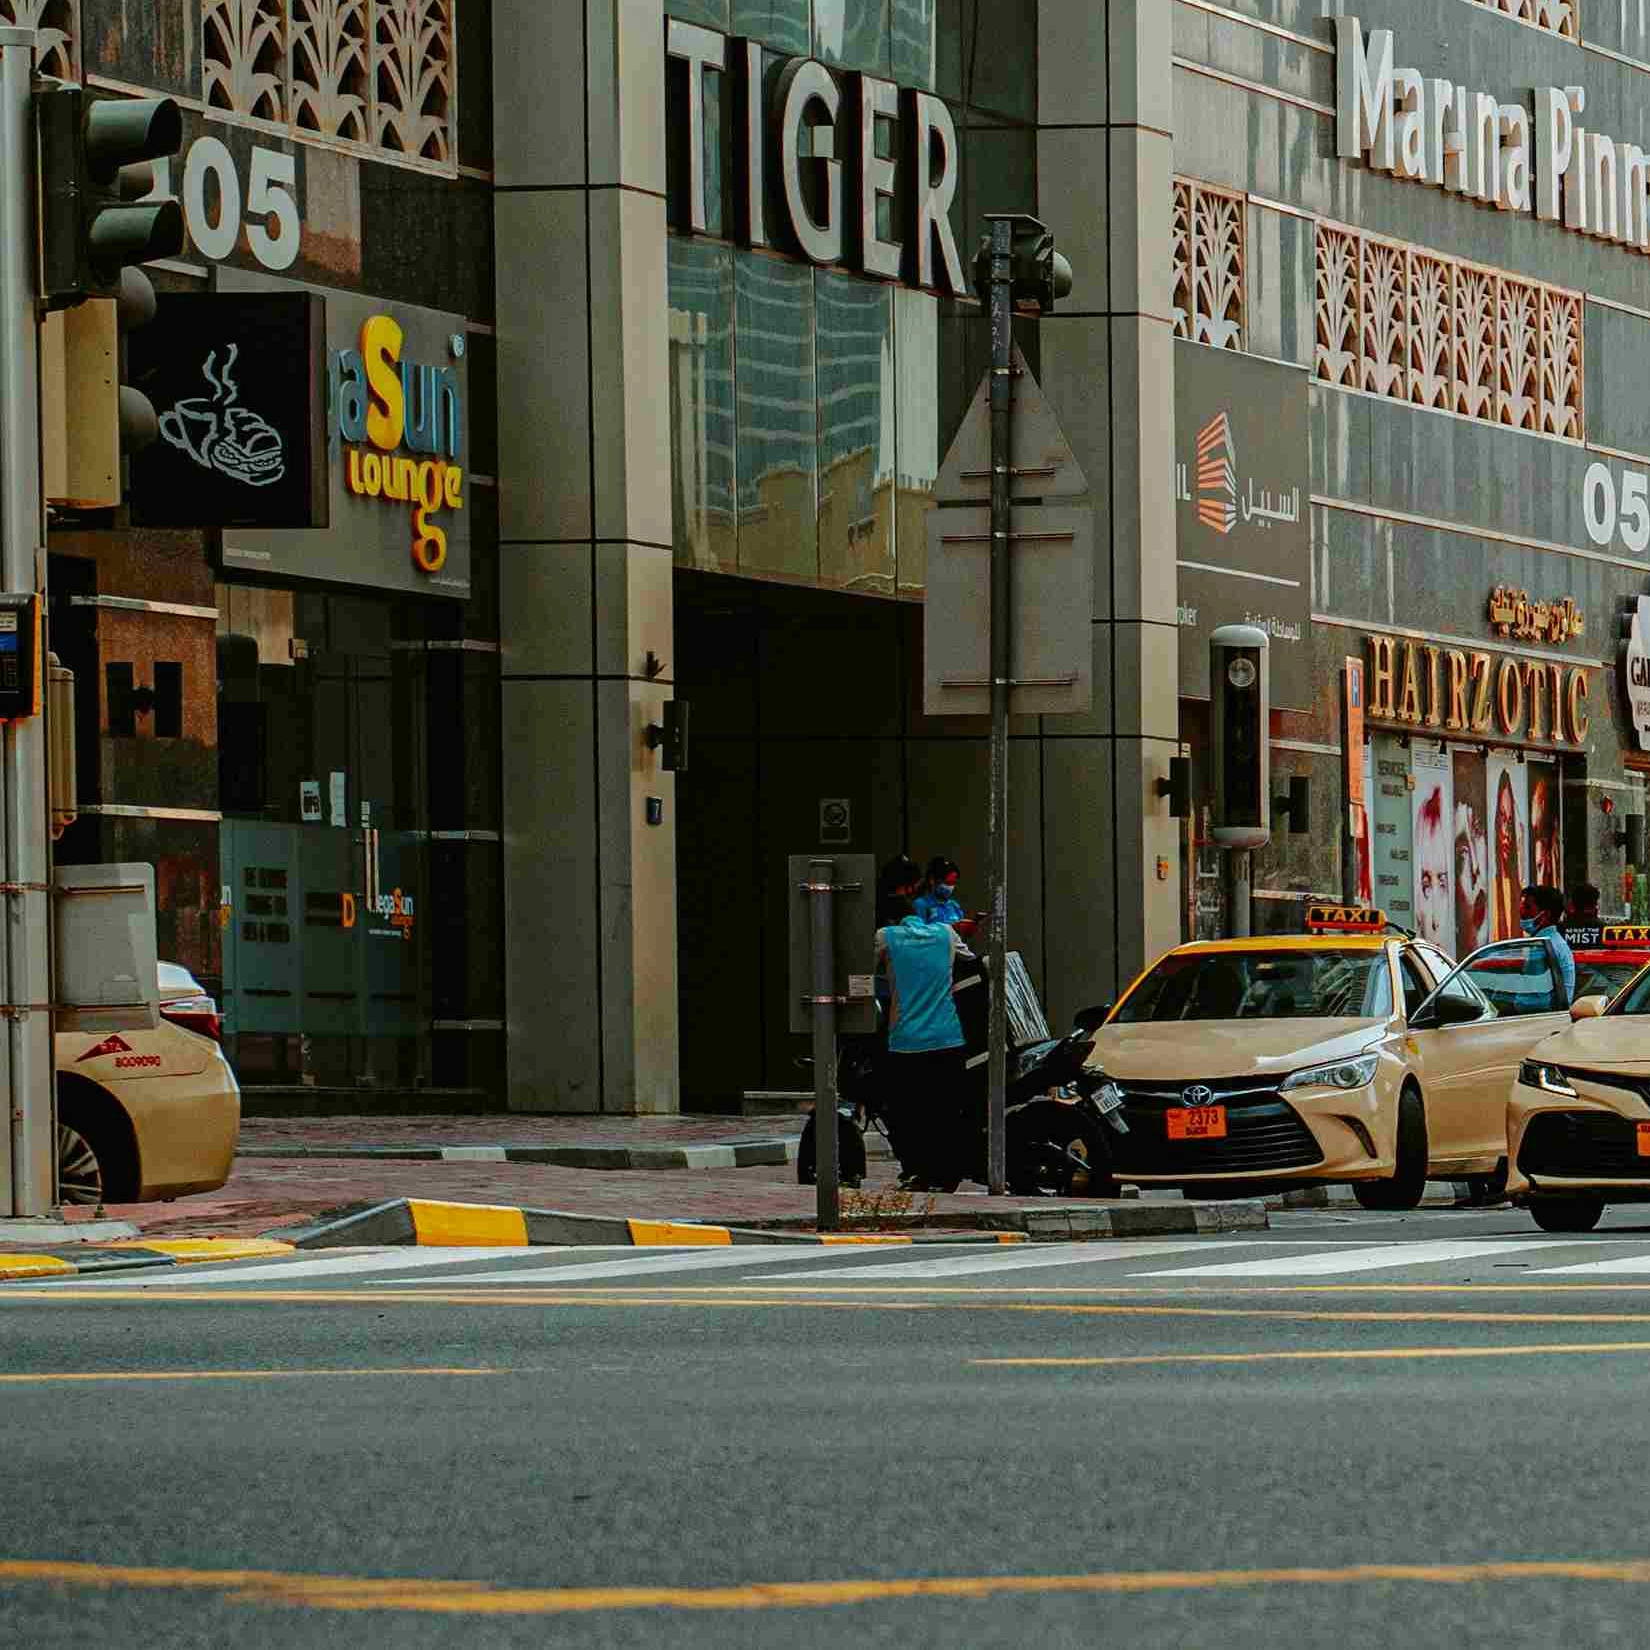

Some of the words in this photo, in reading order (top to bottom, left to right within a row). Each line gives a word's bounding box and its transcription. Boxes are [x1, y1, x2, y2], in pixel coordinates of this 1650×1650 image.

[1335, 15, 1531, 212] Marina
[667, 22, 965, 295] TIGER
[1241, 477, 1300, 530] السبيل
[1368, 633, 1591, 745] HAIRZOTIC
[1320, 909, 1371, 922] TAXI
[1565, 933, 1599, 944] MIST
